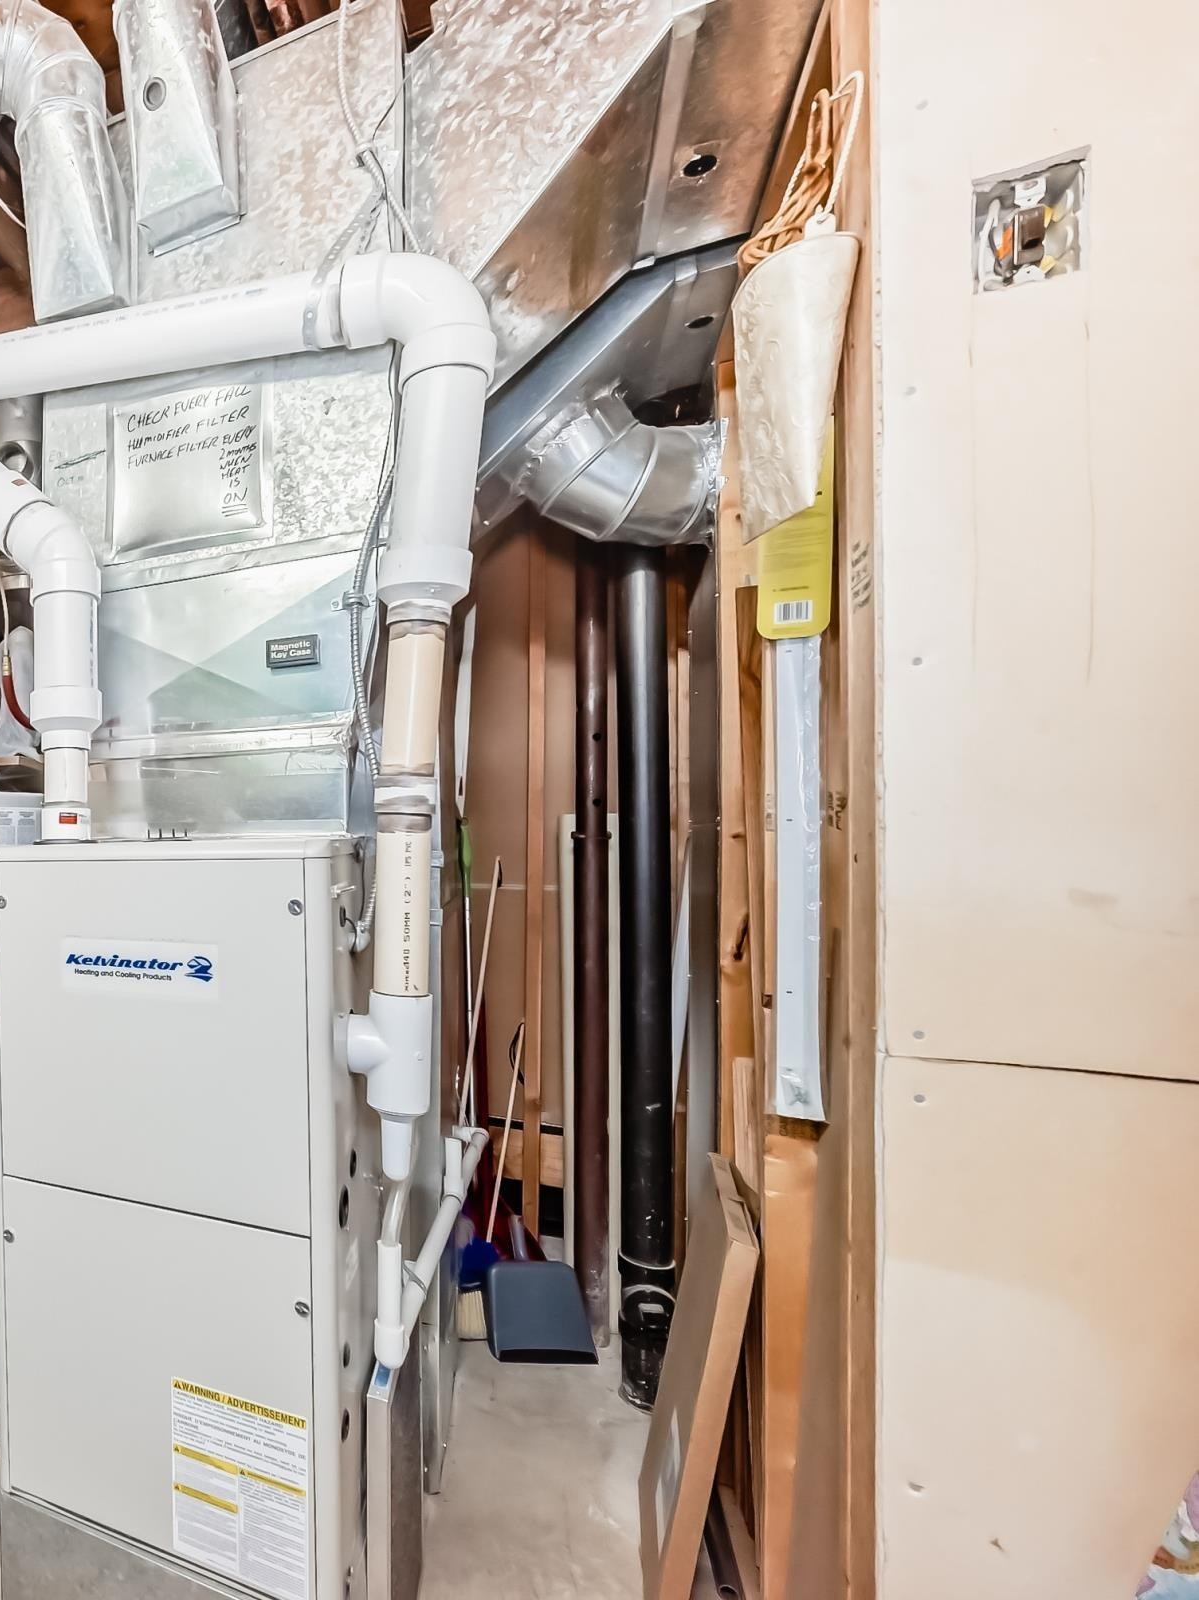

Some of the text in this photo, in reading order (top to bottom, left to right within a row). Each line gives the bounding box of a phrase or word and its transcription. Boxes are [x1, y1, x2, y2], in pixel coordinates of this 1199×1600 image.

[127, 385, 251, 433] CHECK EVERY FALL
[128, 405, 250, 452] HUMIDIFIER FILTER
[127, 425, 258, 469] FURNACE FILTER EVERY
[221, 464, 250, 480] HEAT
[229, 479, 240, 489] IS
[223, 488, 248, 504] ON
[270, 641, 311, 651] Magnetic
[271, 649, 311, 659] Key Case
[403, 912, 411, 942] 50MM
[65, 953, 183, 971] Kelvinator
[74, 968, 99, 977] Heating
[116, 971, 141, 980] Cooling
[142, 973, 172, 981] Products
[181, 1380, 221, 1402] WARNING
[227, 1395, 306, 1428] ADVERTISSEMENT
